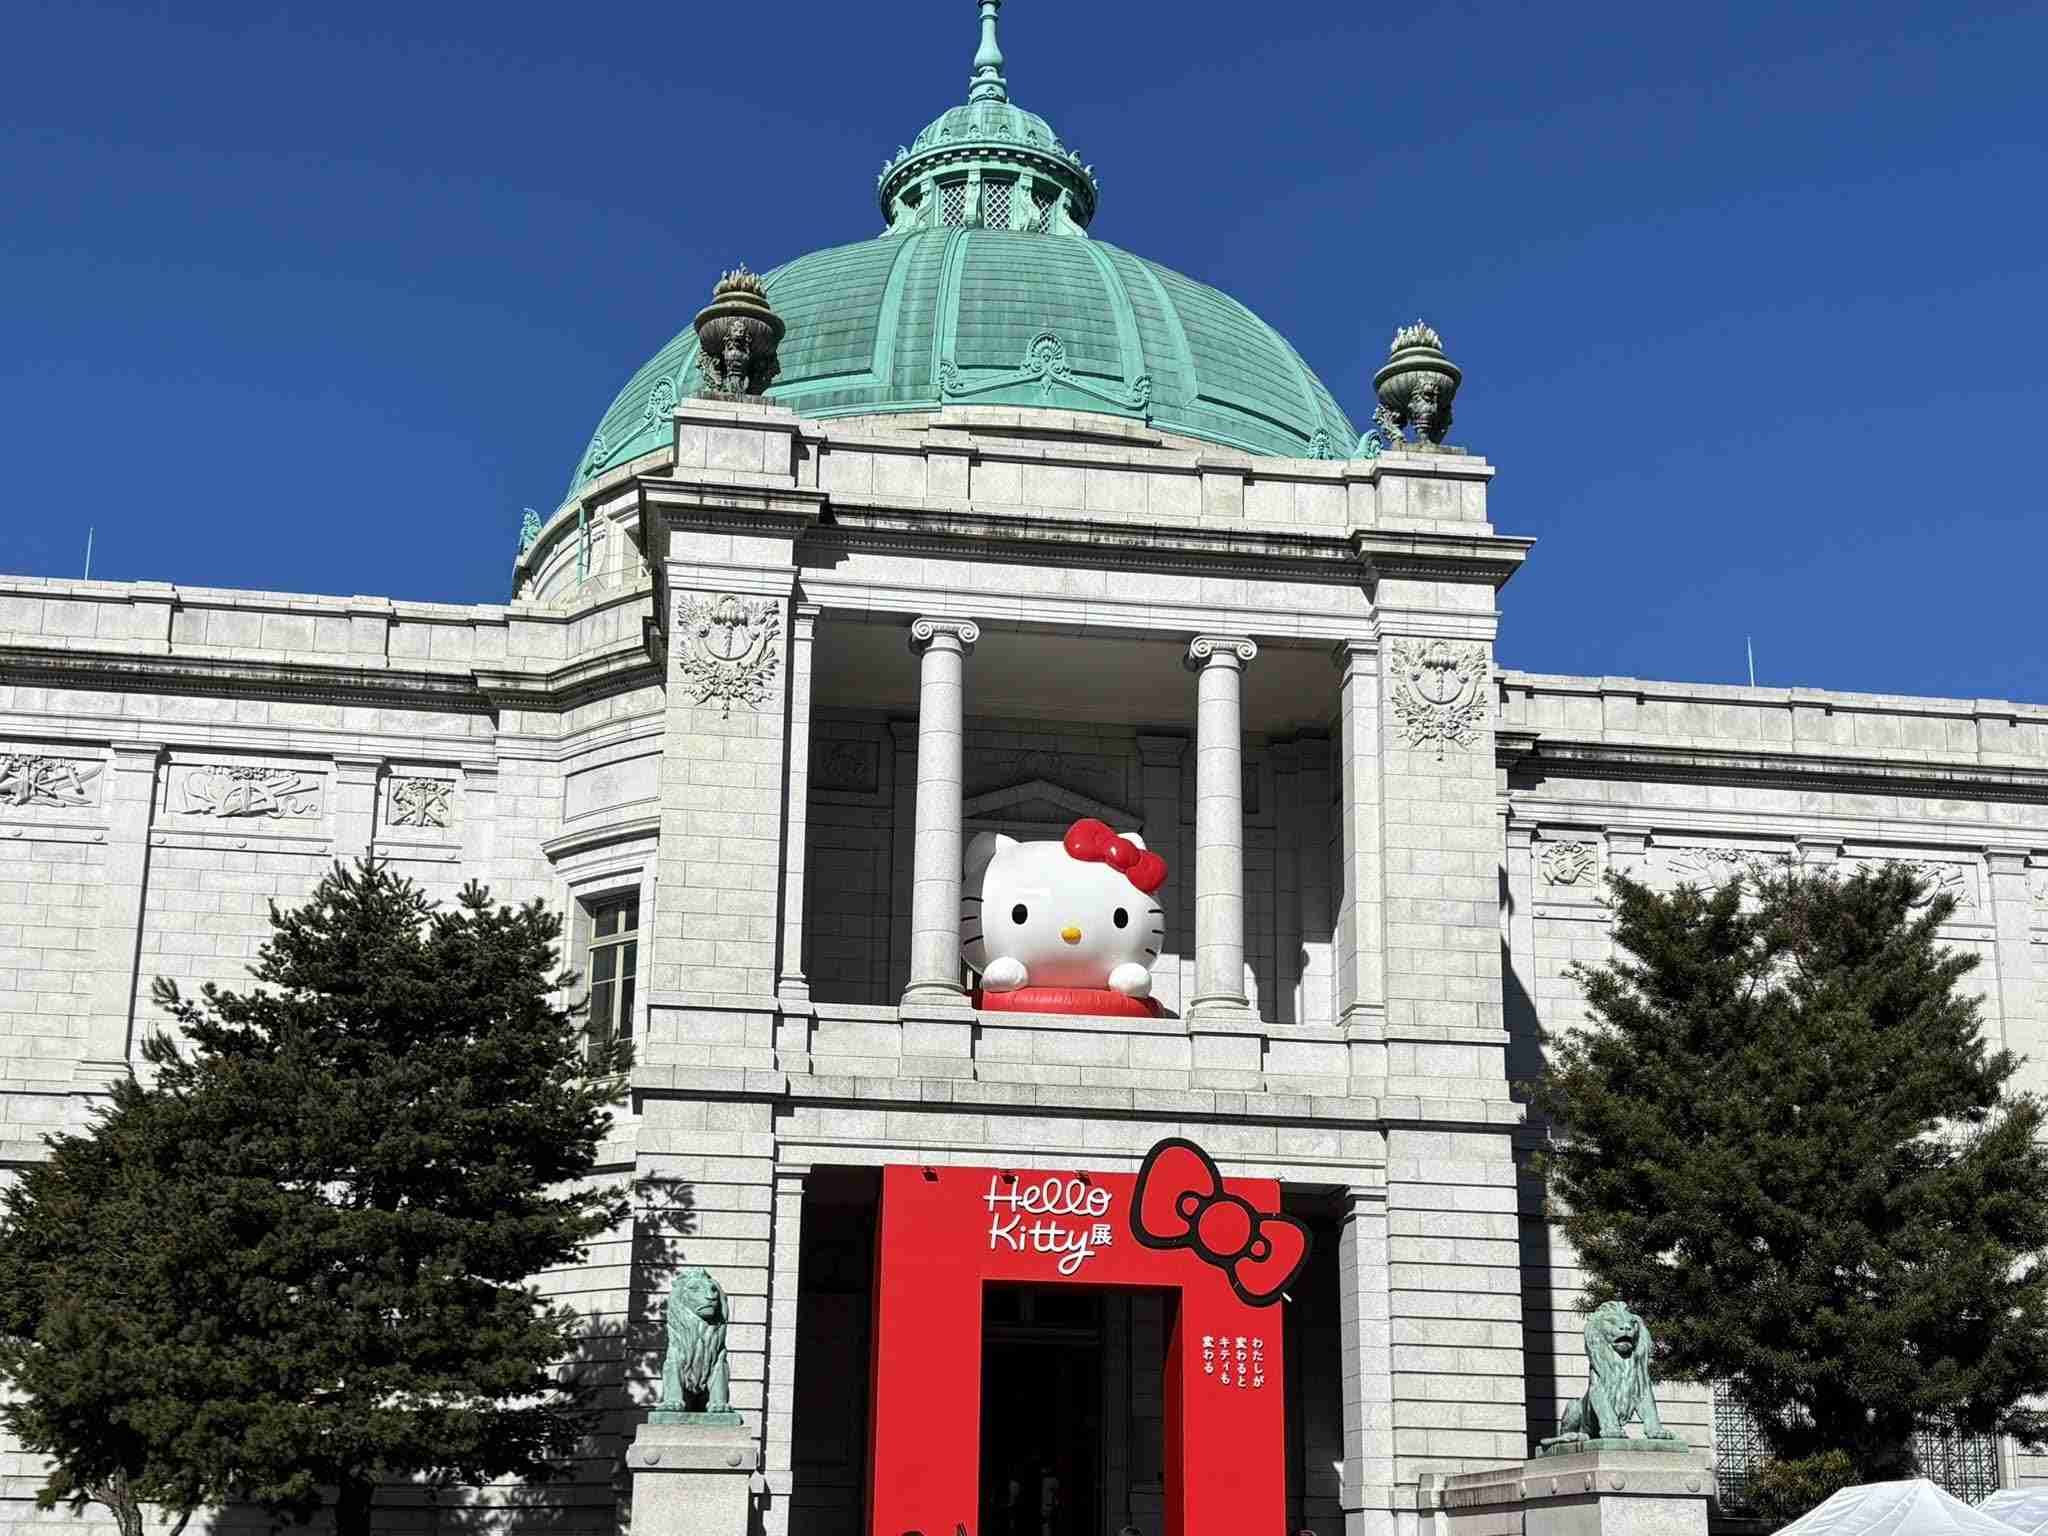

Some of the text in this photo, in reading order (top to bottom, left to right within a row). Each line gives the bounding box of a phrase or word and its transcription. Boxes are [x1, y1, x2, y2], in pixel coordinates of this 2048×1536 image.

[983, 1175, 1112, 1216] Hello
[1202, 1336, 1214, 1373] 変わる
[1219, 1337, 1231, 1384] キティも
[1235, 1337, 1247, 1387] 変わると
[1252, 1338, 1264, 1387] わたしが
